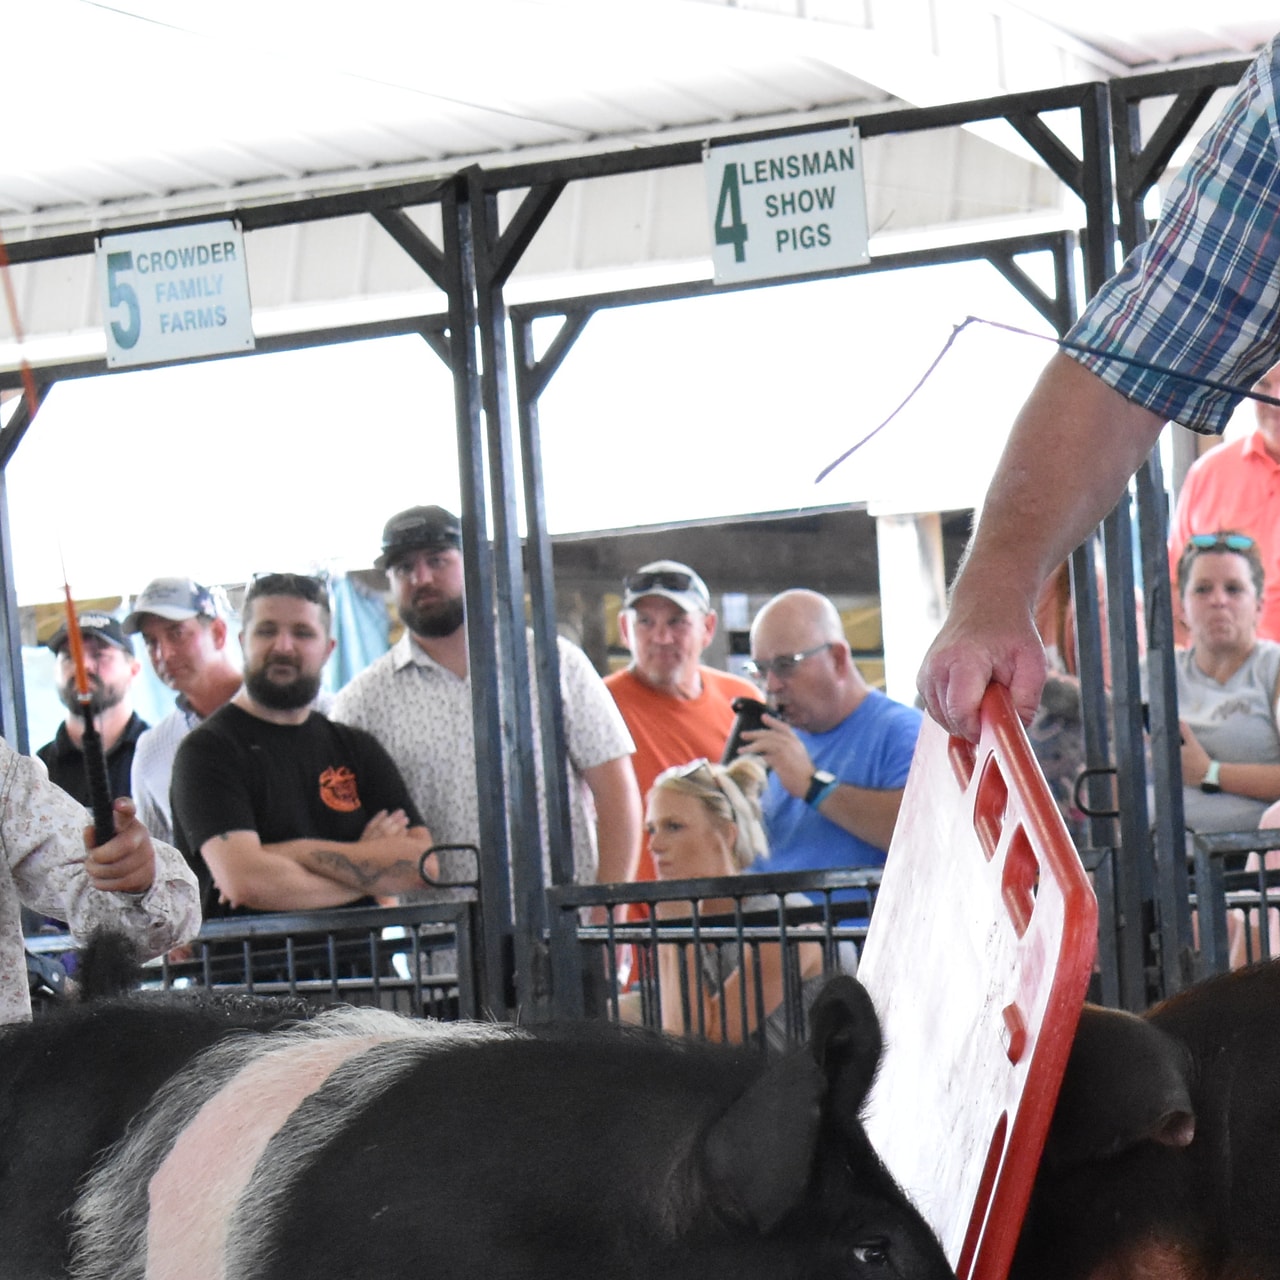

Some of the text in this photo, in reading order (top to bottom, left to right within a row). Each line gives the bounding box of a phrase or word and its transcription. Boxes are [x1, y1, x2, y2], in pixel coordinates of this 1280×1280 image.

[741, 147, 855, 185] LENSMAN
[715, 163, 748, 262] 4
[765, 186, 836, 218] SHOW
[776, 223, 831, 253] PIGS
[136, 241, 237, 274] CROWDER
[107, 251, 141, 350] 5
[155, 273, 224, 304] FAMILY
[160, 305, 227, 334] FARMS
